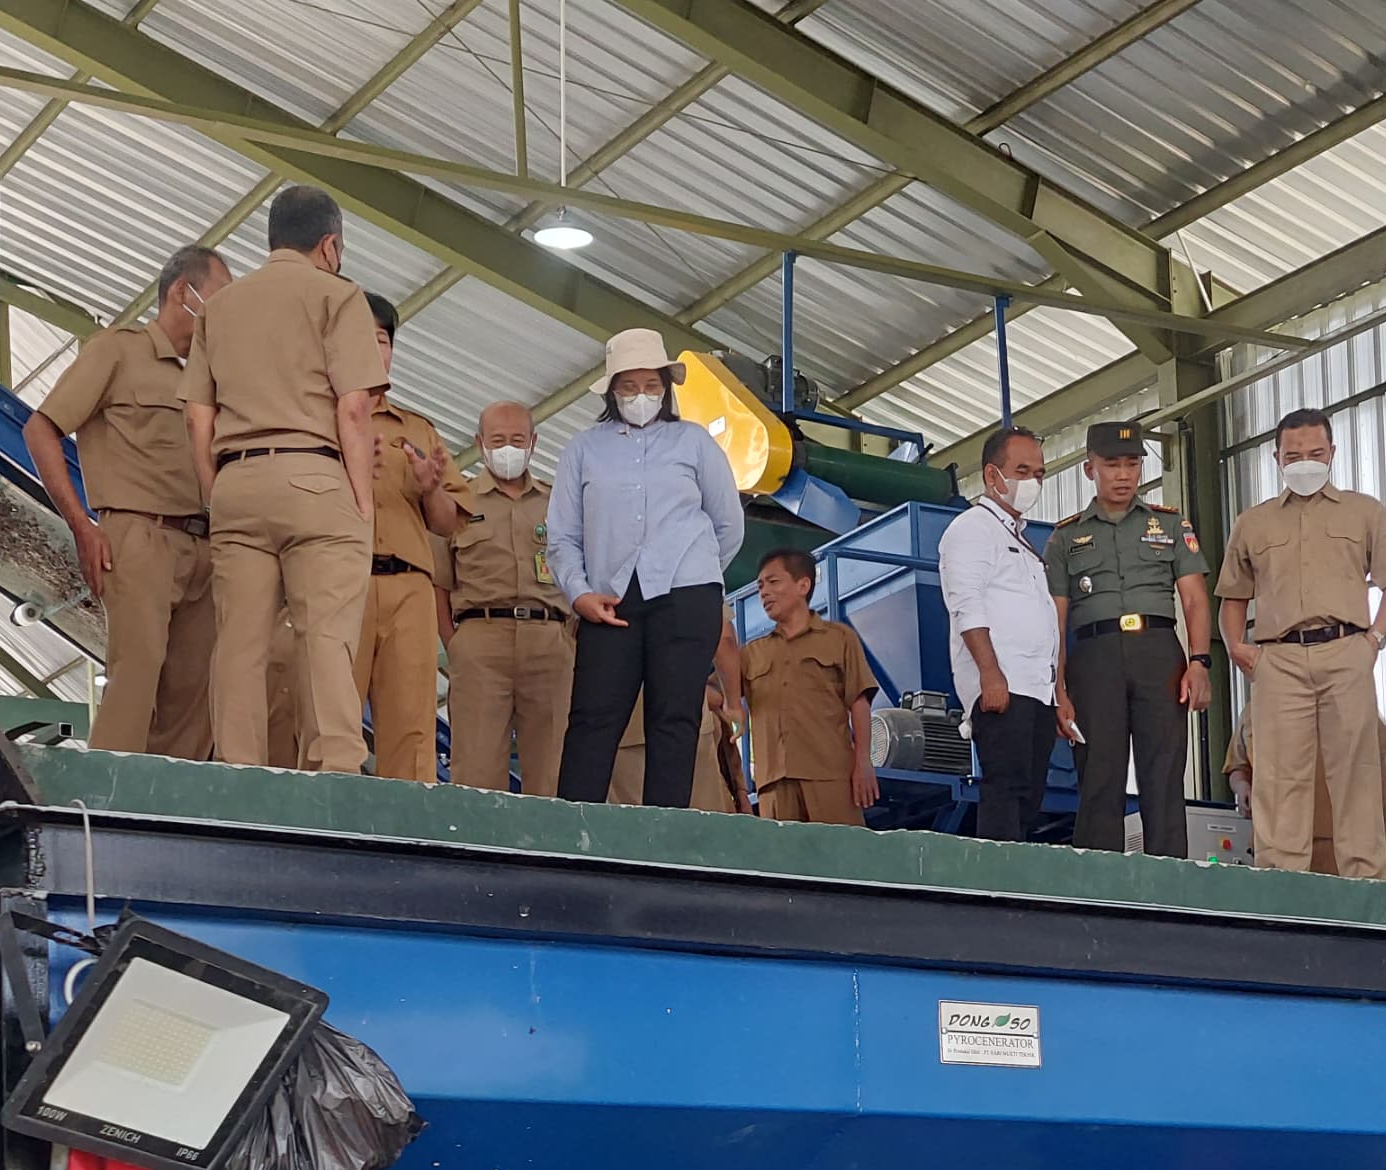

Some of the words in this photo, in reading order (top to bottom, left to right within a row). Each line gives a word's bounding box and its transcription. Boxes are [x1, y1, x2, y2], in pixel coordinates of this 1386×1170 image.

[948, 1014, 990, 1028] DONG
[1009, 1017, 1031, 1030] SO
[37, 1105, 68, 1121] 100W
[99, 1124, 142, 1144] ZENICH
[175, 1147, 200, 1161] IP66
